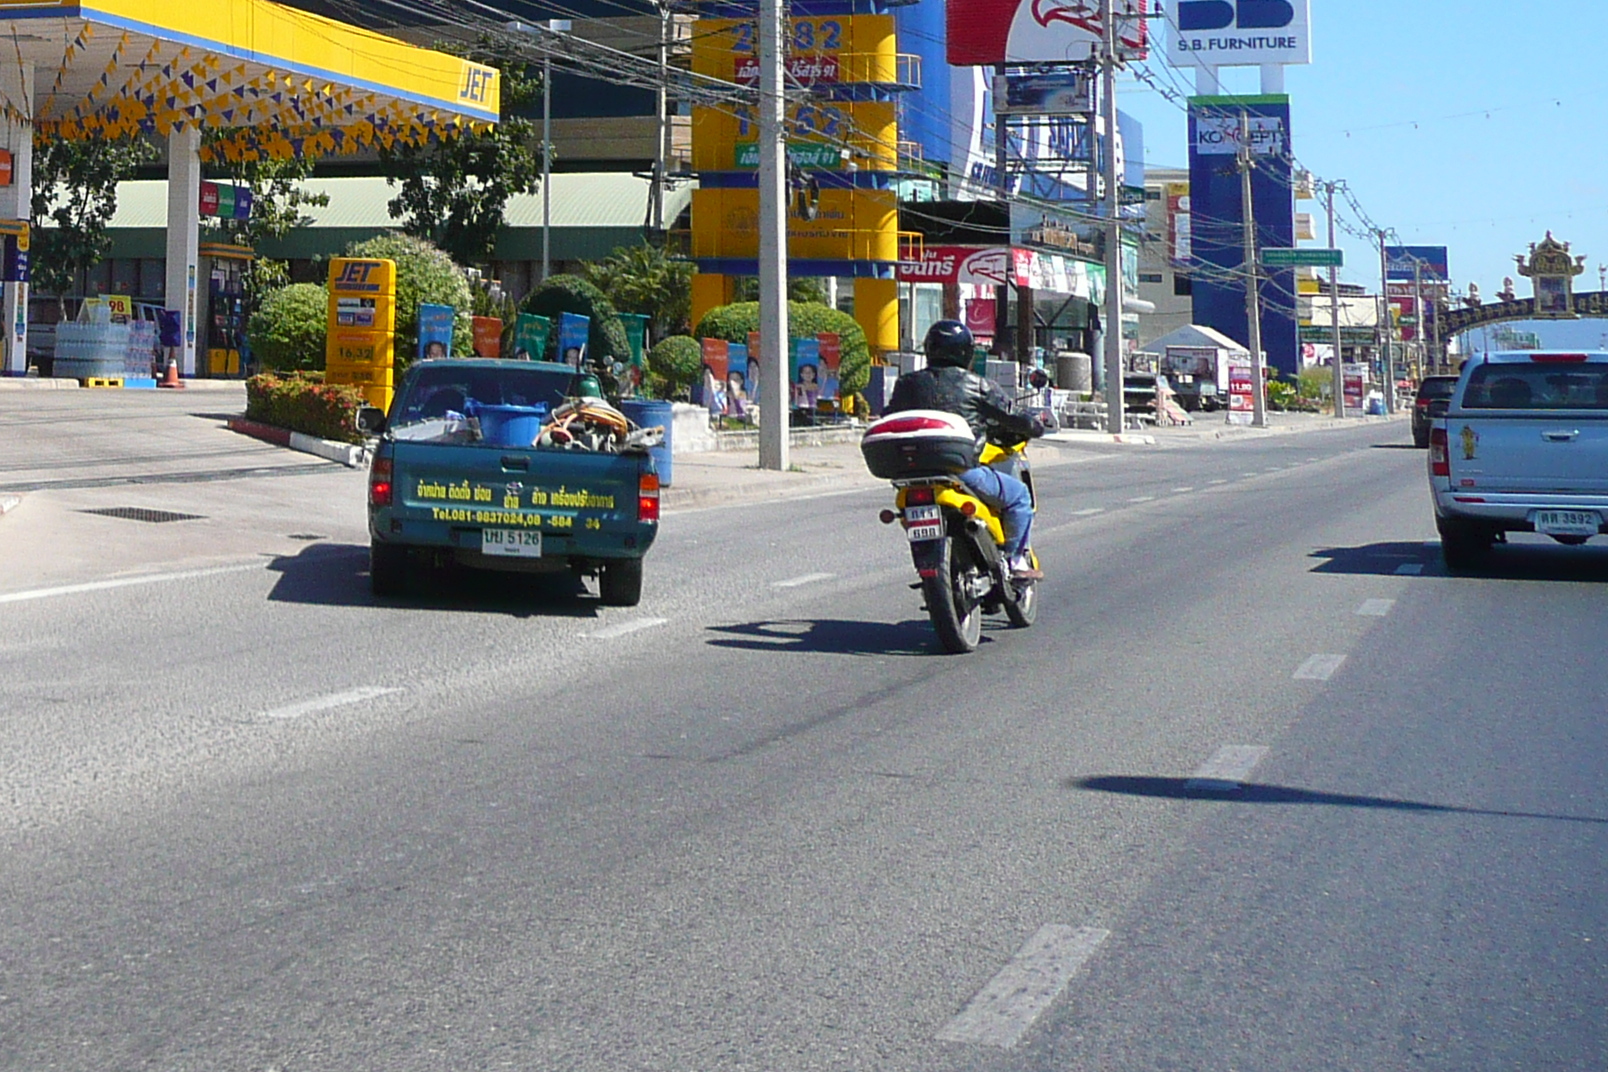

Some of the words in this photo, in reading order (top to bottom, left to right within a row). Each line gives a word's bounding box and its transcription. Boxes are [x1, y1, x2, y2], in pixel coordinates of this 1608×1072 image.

[1209, 37, 1297, 50] FURNITURE
[460, 67, 494, 103] JET
[335, 262, 381, 282] JET
[508, 530, 539, 546] 5126
